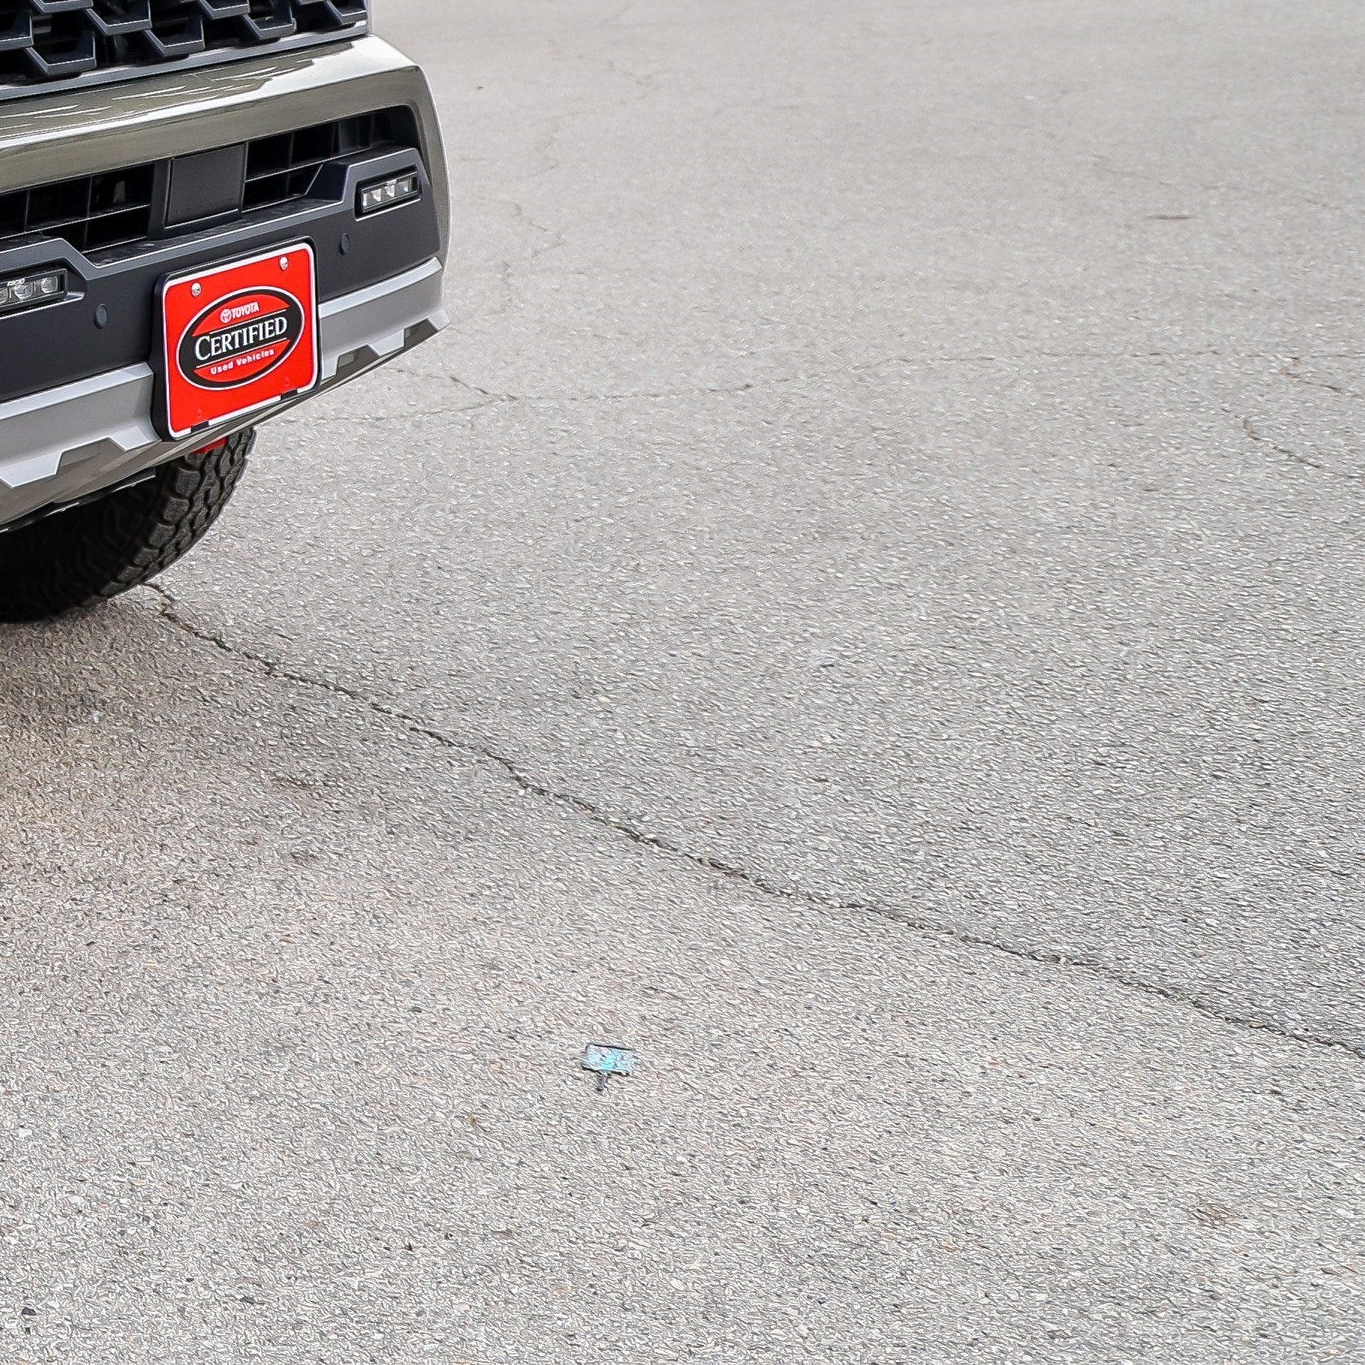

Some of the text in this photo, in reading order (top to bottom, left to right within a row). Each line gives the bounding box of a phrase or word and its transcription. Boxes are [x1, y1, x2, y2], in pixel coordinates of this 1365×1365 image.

[231, 302, 260, 320] TOYOTA
[195, 316, 288, 361] CERTIFIED
[210, 349, 275, 375] Used Vehicles
